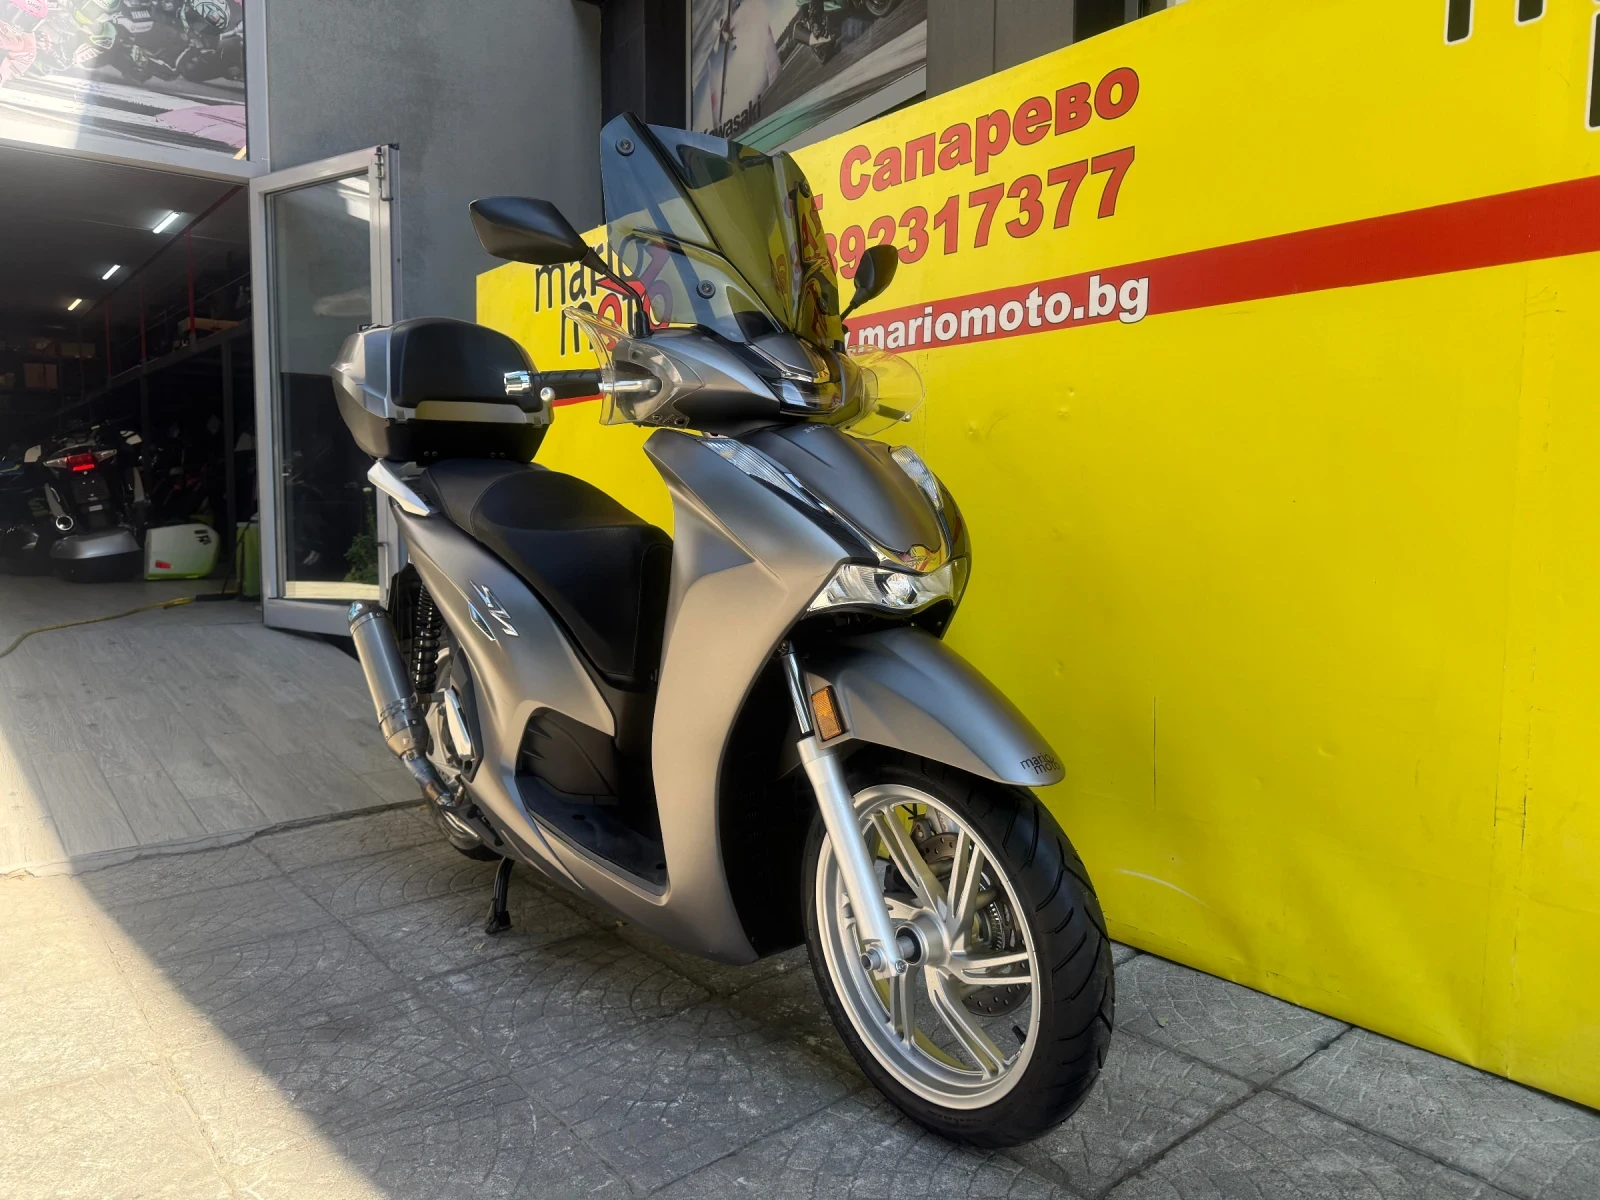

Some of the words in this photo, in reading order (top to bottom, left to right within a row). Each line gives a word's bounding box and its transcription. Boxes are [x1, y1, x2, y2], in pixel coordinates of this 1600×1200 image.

[701, 94, 761, 138] awasaki
[839, 67, 1139, 200] Сапарево
[844, 273, 1149, 353] .mariomoto.bg
[1020, 753, 1053, 769] mario
[1034, 761, 1060, 774] moto
